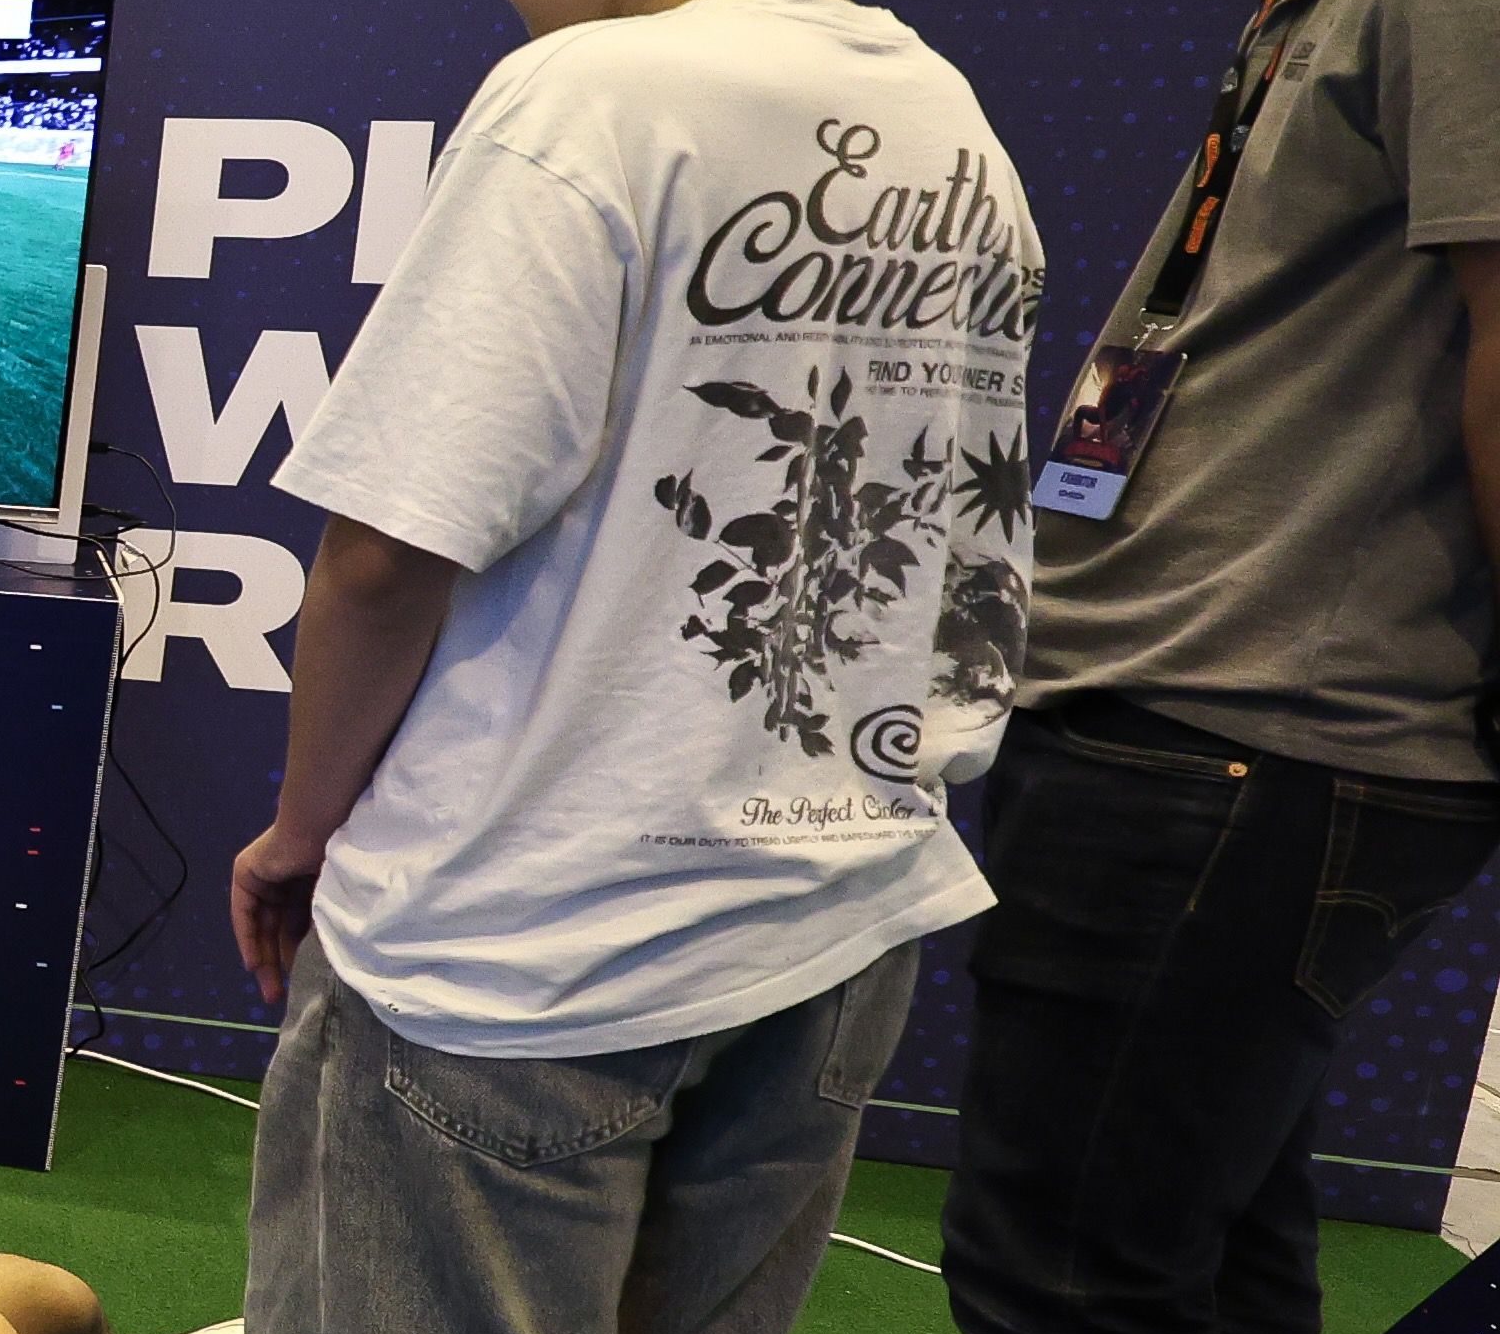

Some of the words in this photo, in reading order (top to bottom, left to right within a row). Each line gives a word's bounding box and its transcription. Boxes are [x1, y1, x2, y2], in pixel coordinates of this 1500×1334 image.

[868, 361, 912, 382] FIND
[740, 796, 783, 826] The
[786, 796, 854, 833] Perfect
